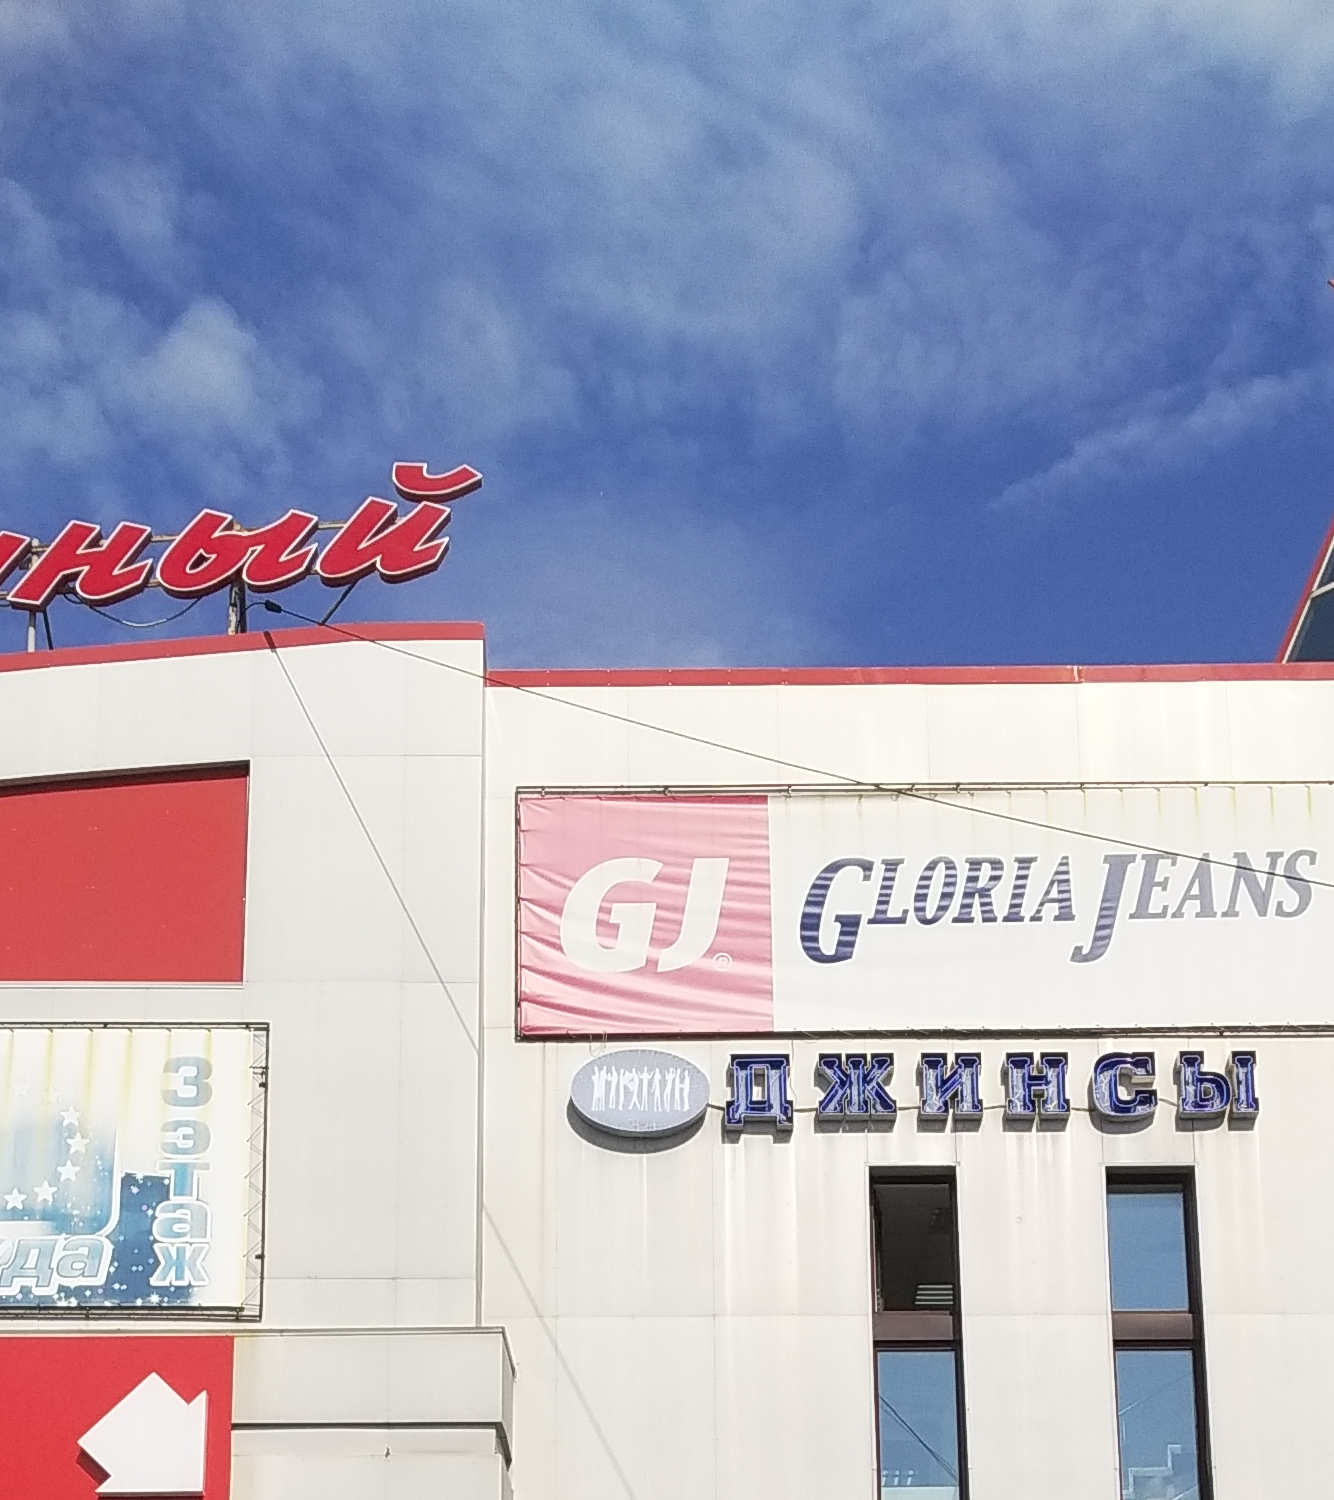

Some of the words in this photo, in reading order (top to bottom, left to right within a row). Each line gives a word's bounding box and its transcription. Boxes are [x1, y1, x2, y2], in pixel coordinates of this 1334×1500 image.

[799, 855, 1076, 964] GLORIA
[1070, 850, 1318, 964] JEANS
[722, 1051, 1259, 1130] ДЖИНСЫ
